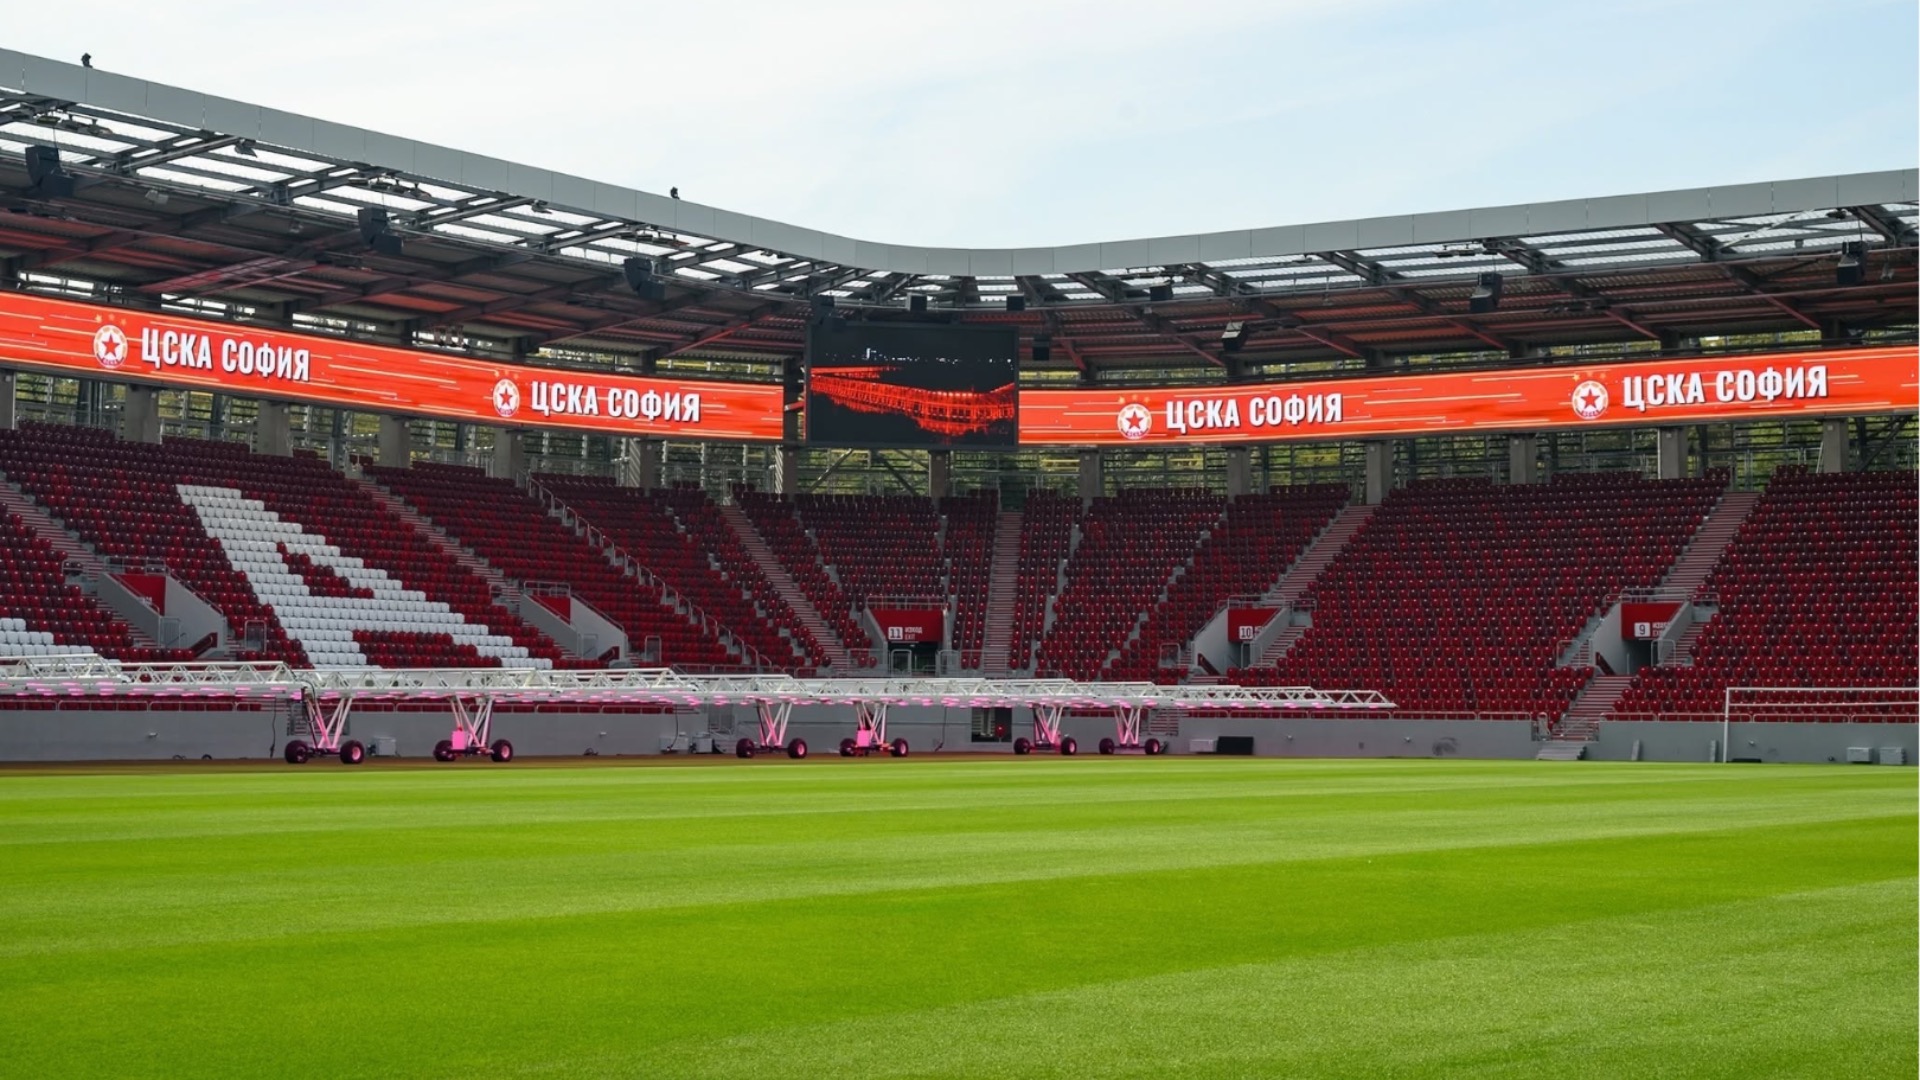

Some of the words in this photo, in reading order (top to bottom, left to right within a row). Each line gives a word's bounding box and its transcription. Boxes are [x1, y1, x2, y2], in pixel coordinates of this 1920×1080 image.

[141, 327, 212, 369] ЦСКА
[221, 338, 310, 381] СОФИЯ
[531, 381, 599, 416] ЦСКА
[607, 388, 700, 422] СОФИЯ
[1623, 372, 1706, 412] ЦСКА
[1716, 365, 1828, 402] СОФИЯ
[1166, 399, 1240, 434] ЦСКА
[1250, 393, 1343, 427] СОФИЯ
[890, 627, 902, 639] 11
[1240, 627, 1252, 638] 10
[1638, 624, 1647, 635] 9
